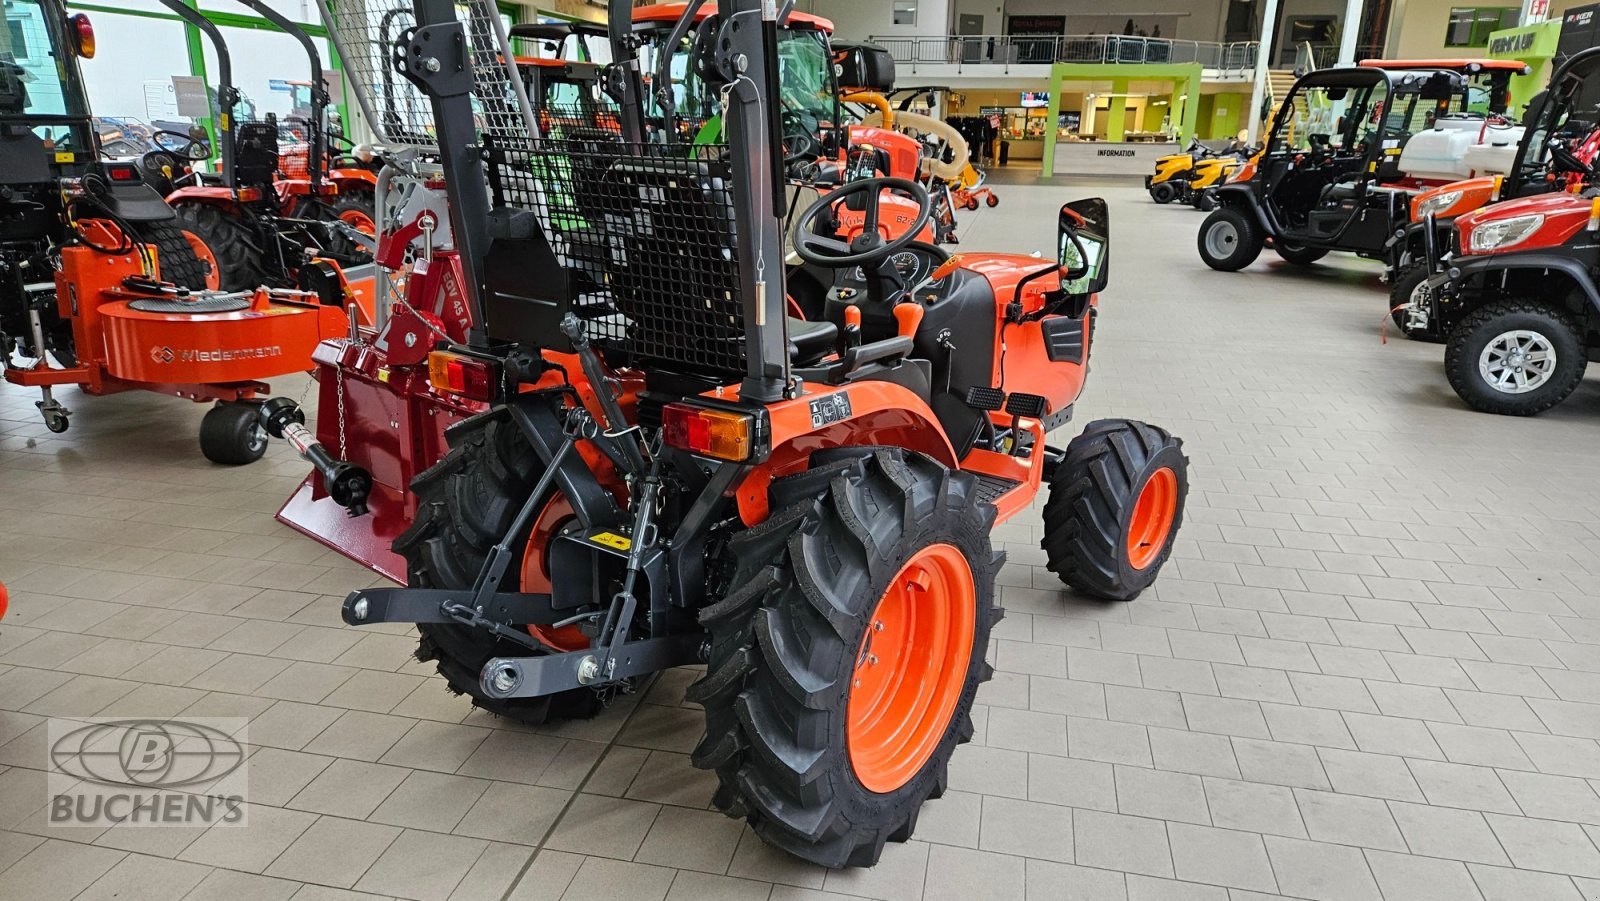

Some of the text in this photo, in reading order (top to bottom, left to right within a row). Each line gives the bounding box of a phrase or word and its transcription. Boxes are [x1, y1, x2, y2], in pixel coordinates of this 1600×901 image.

[1097, 149, 1136, 157] INFORMATION
[442, 272, 468, 329] EGV 45 A
[180, 345, 282, 362] Wiedenmann
